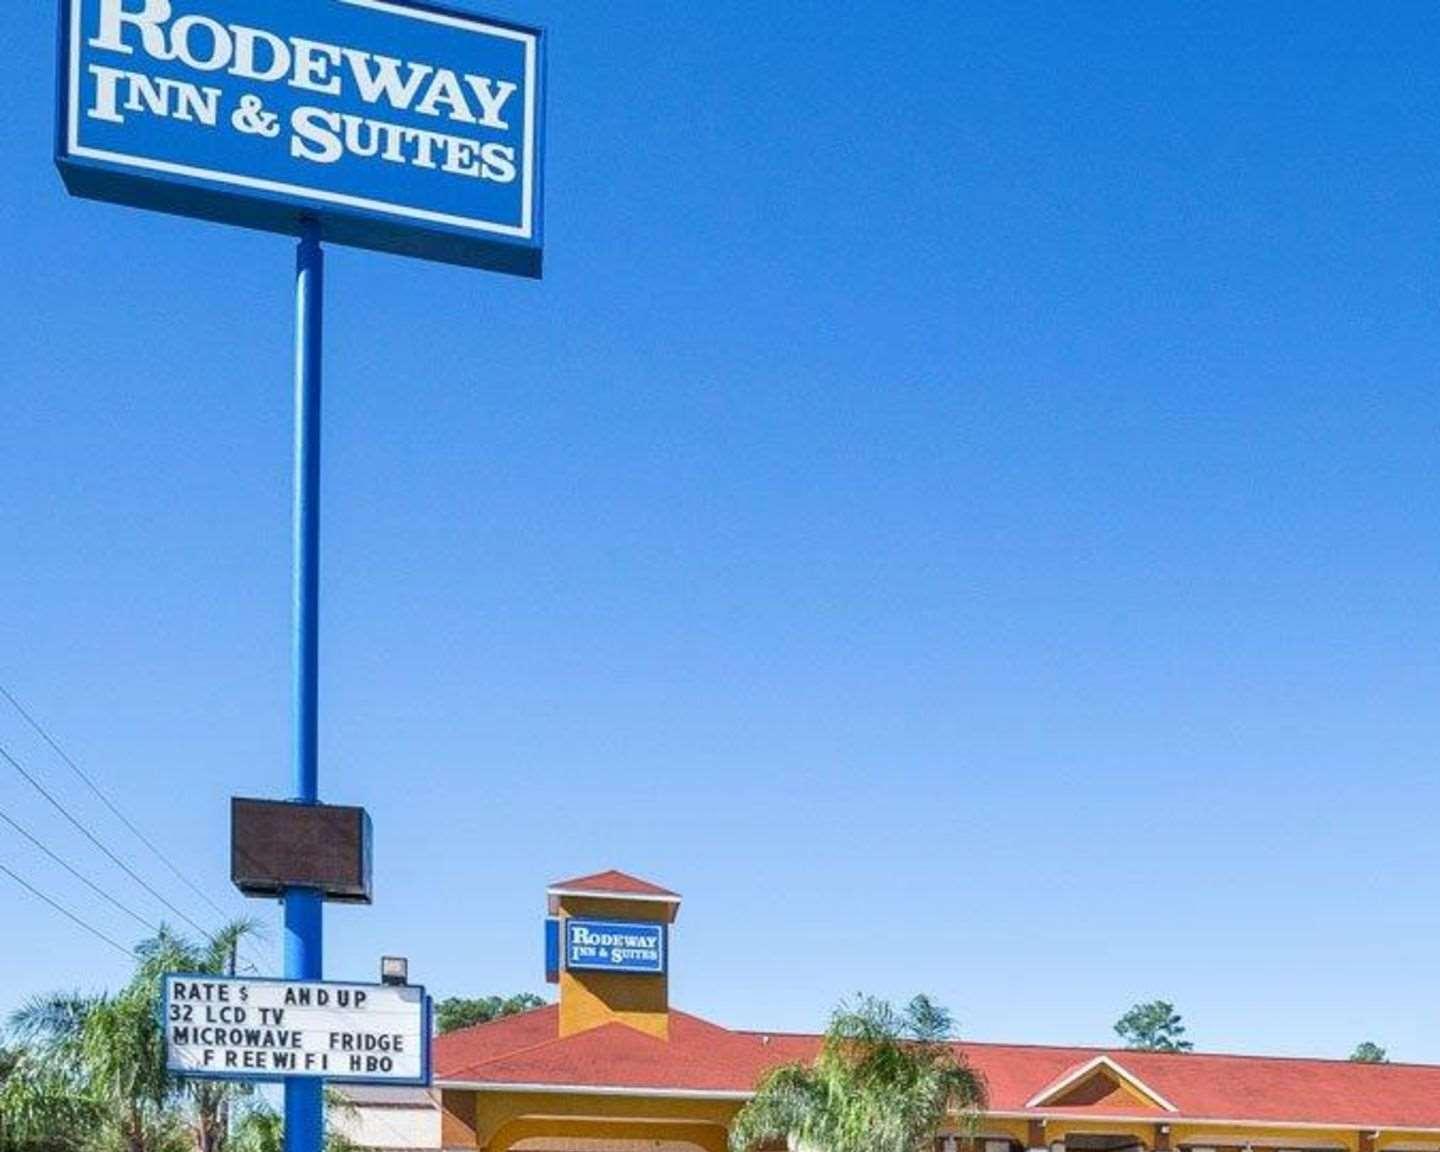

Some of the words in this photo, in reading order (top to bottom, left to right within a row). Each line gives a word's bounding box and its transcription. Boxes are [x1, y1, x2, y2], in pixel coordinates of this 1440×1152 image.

[89, 0, 517, 130] RODEWAY
[88, 65, 222, 126] INN
[231, 94, 280, 138] &
[290, 106, 516, 184] SUITES
[572, 927, 657, 947] RODEWAY
[572, 947, 597, 961] INN
[611, 948, 657, 963] SUITES
[174, 983, 229, 1001] RATE
[170, 1004, 193, 1021] 32
[206, 1006, 246, 1024] LCD
[258, 1008, 285, 1025] TV
[174, 1026, 302, 1049] MICROWAVE
[330, 1032, 403, 1052] FRIDGE
[350, 1054, 393, 1072] HBO
